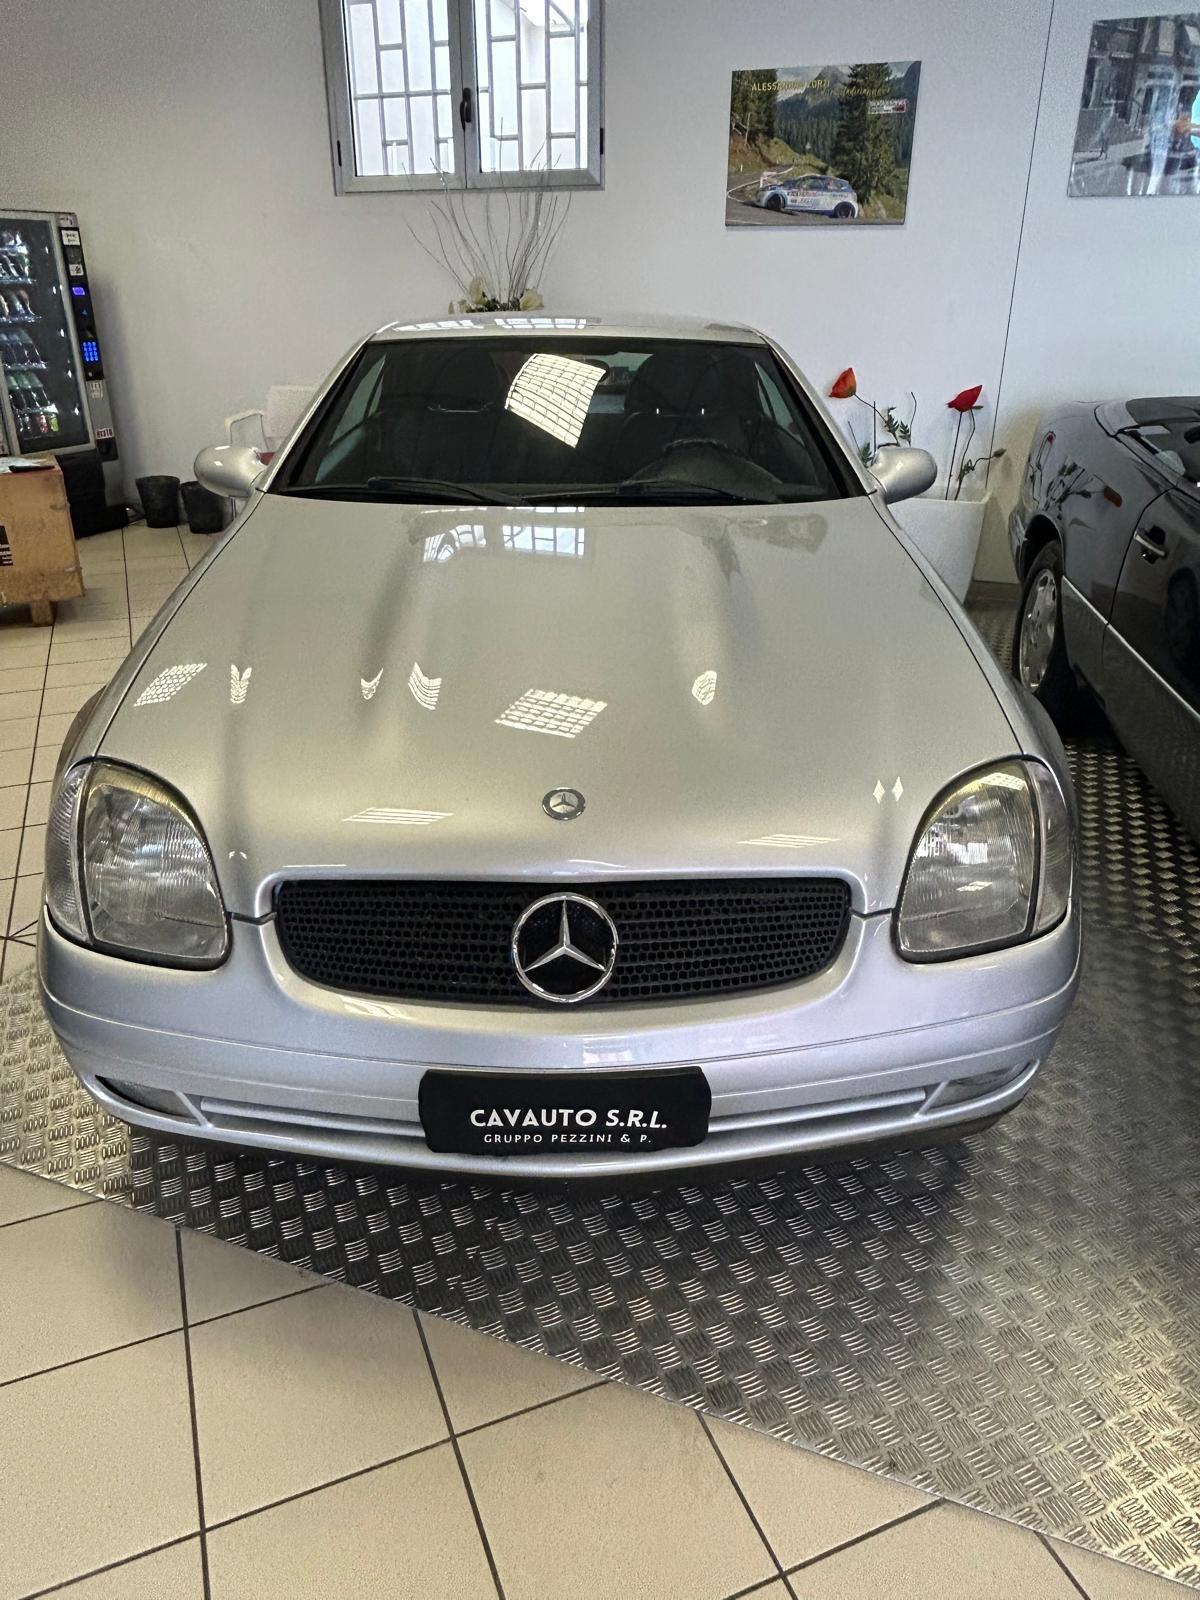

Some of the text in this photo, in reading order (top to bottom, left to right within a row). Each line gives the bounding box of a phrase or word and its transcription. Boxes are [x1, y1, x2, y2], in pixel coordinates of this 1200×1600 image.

[470, 1108, 668, 1129] CAVAUTO S.R.L.
[484, 1133, 652, 1144] GRUPPO PEZZINI & P.
